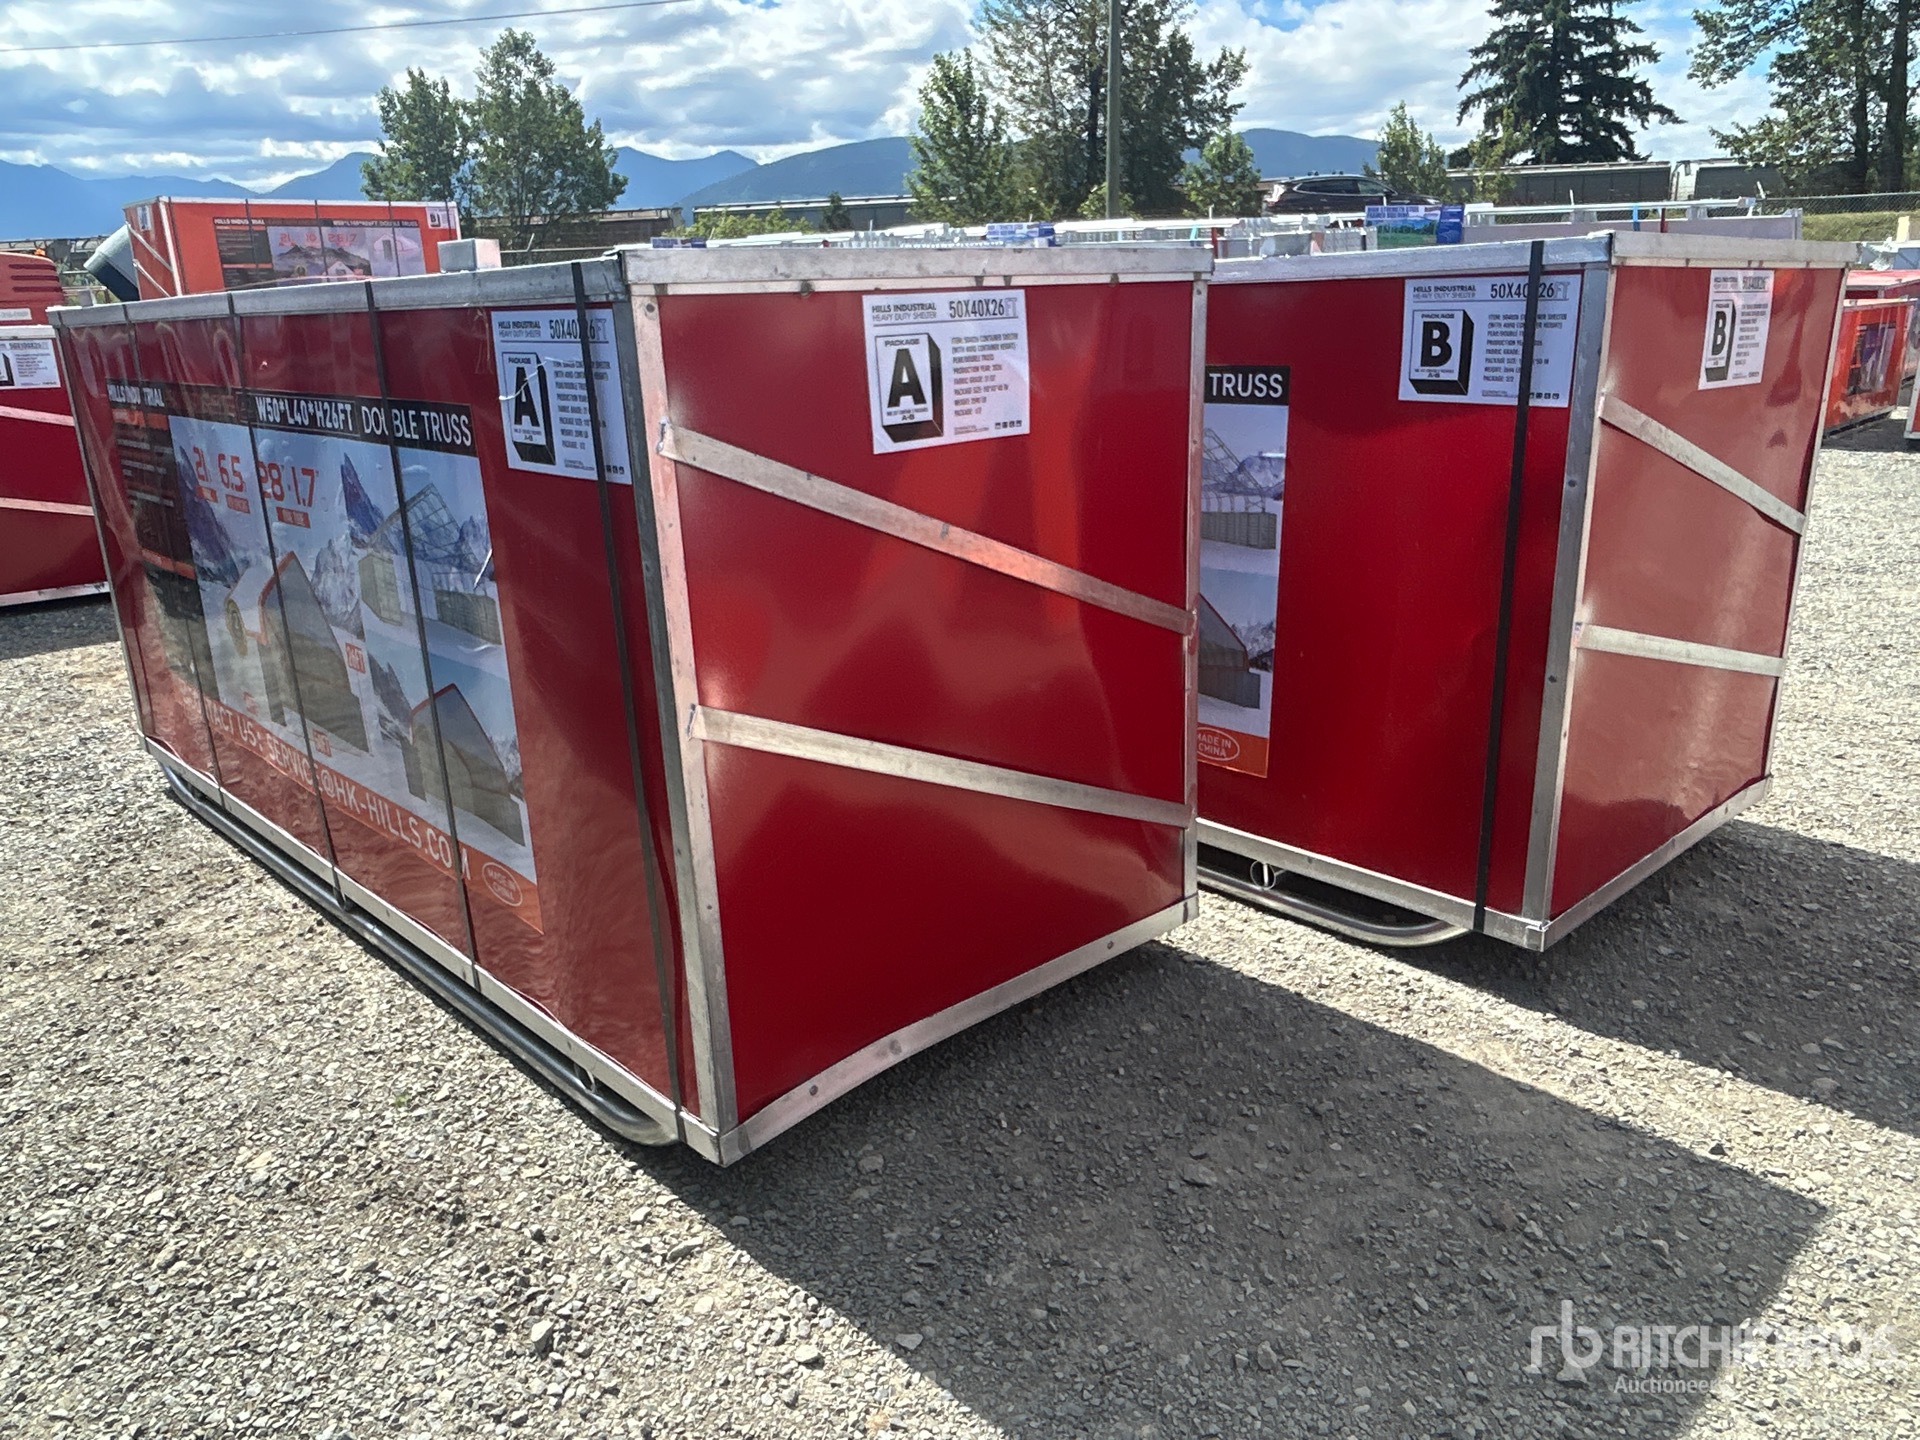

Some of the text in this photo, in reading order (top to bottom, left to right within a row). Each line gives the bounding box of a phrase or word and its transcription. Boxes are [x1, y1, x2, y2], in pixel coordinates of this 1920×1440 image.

[1490, 281, 1570, 300] 50X4026FT
[871, 305, 891, 313] HILLS
[893, 303, 937, 312] INDUSTRIAL
[872, 311, 937, 321] HEAVY DUTY SHELTER
[498, 321, 511, 329] HILLS
[512, 321, 541, 329] INDUSTRIAL
[1711, 311, 1727, 356] B
[885, 338, 919, 347] PACKAGE
[1421, 321, 1452, 367] B
[887, 348, 927, 408] A
[1208, 372, 1284, 398] TRUSS
[107, 384, 126, 403] HILLS
[514, 367, 540, 427] A
[422, 411, 472, 447] TRUSS
[1221, 738, 1231, 749] IN
